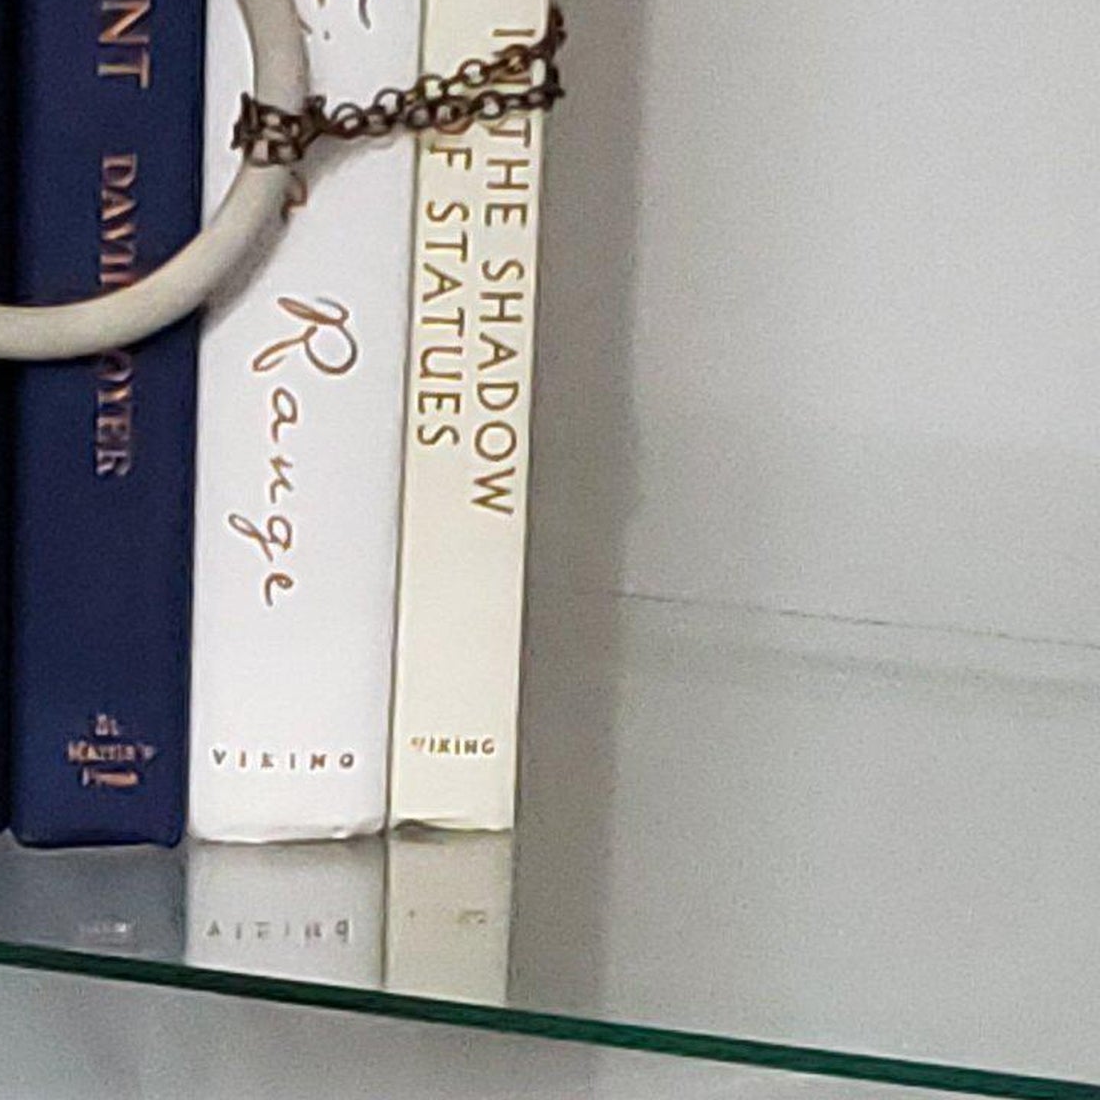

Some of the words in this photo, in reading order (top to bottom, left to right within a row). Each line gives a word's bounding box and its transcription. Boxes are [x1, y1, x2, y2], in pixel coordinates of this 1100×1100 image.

[483, 122, 531, 228] THE
[417, 200, 471, 446] STATUES
[471, 259, 524, 516] SHADOW
[228, 297, 358, 606] Range
[411, 737, 494, 755] VIKING
